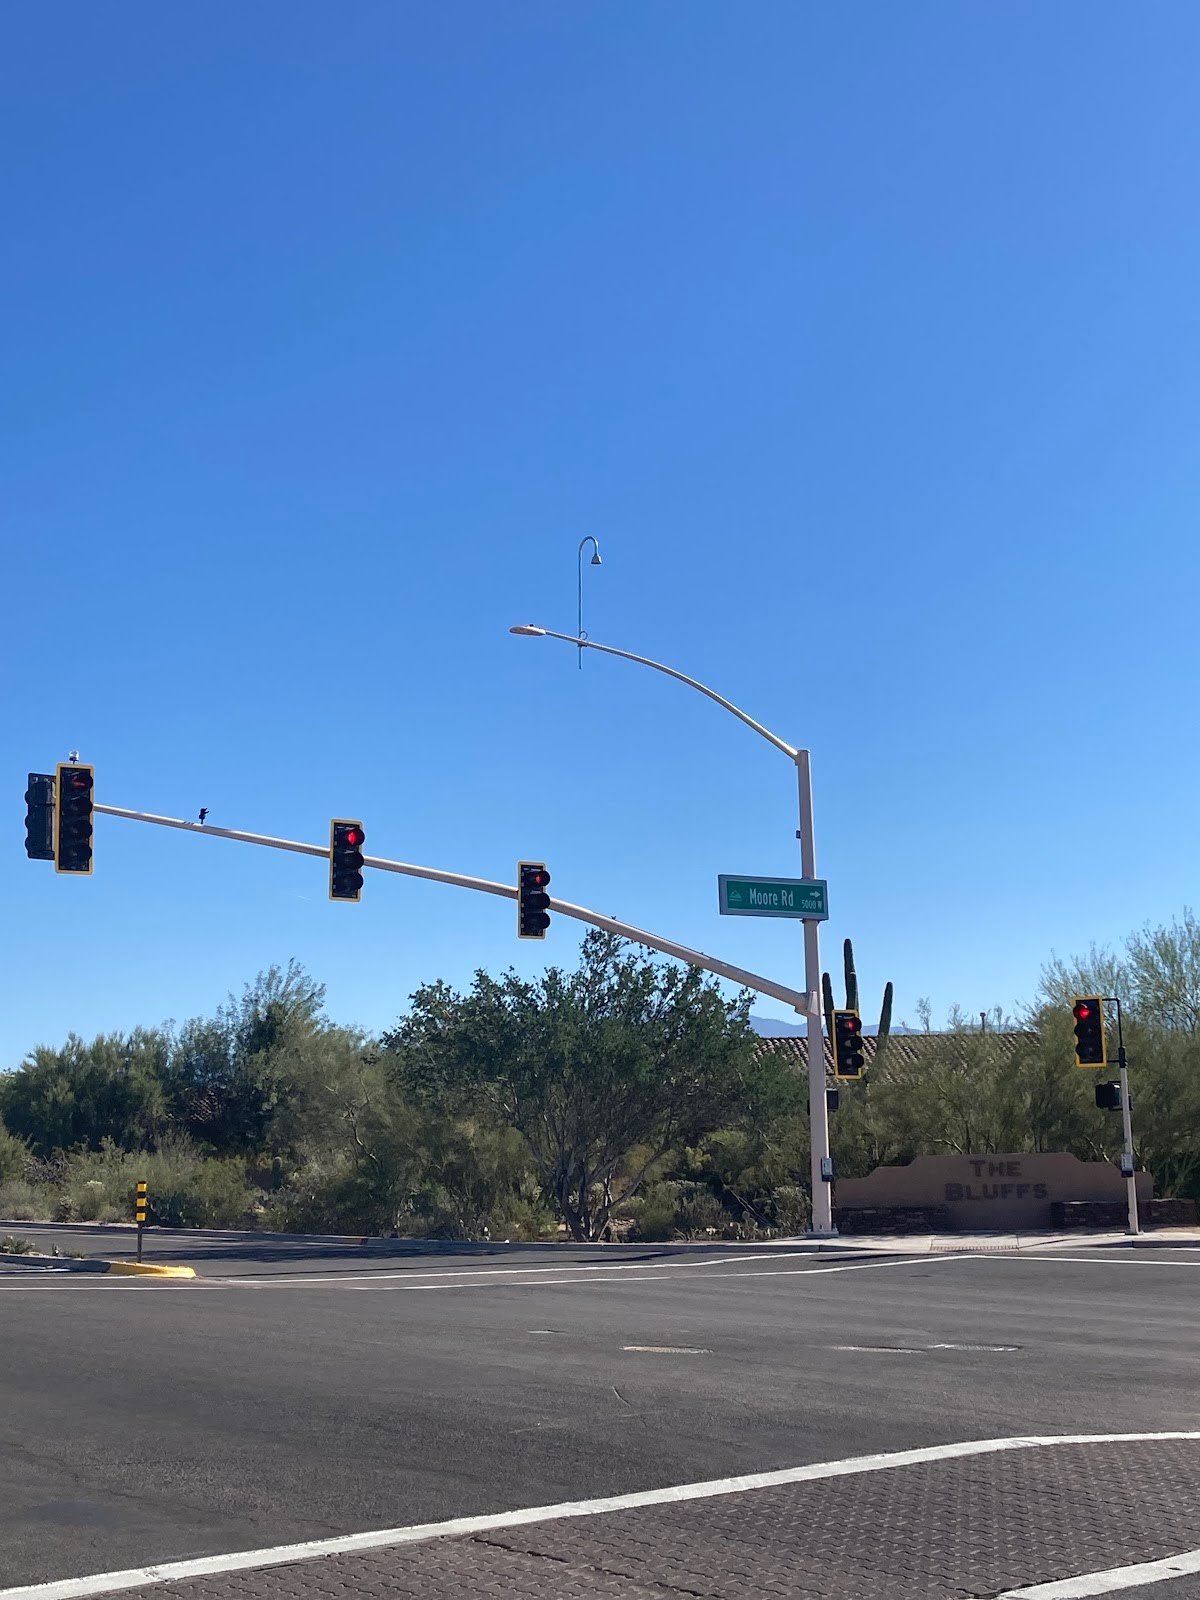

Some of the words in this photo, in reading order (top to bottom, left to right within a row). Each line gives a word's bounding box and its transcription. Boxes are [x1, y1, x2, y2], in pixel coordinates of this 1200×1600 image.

[749, 888, 778, 906] Moore
[781, 889, 794, 907] Rd
[801, 899, 817, 909] 5000
[968, 1160, 1021, 1177] THE
[944, 1183, 1048, 1201] BLUFFS
